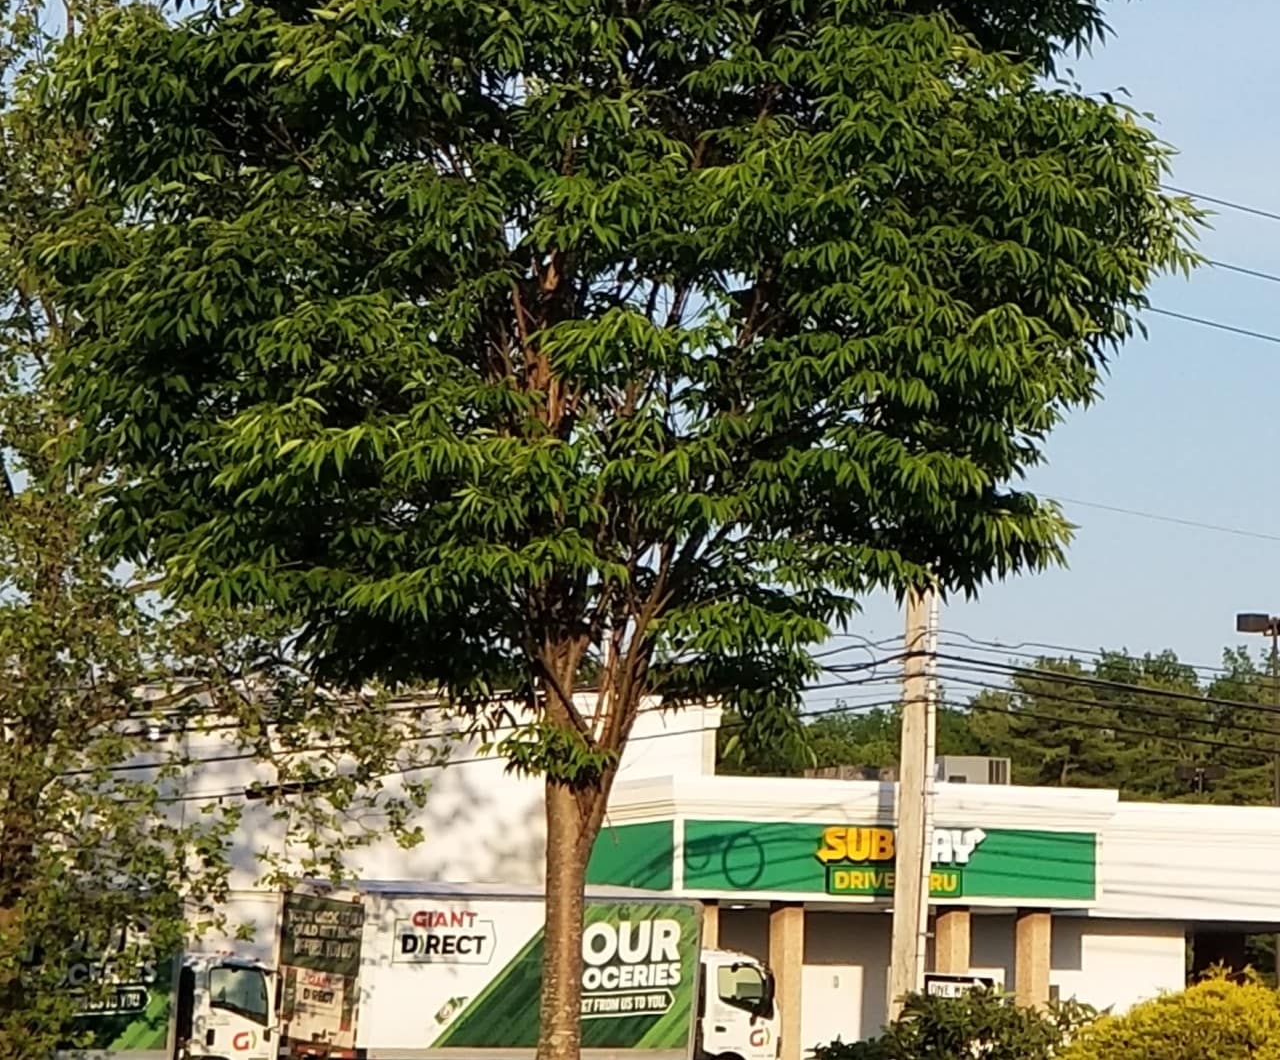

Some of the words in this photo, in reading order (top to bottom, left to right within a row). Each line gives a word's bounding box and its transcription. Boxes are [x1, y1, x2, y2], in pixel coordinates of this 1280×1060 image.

[816, 826, 987, 864] SUBAY
[834, 871, 896, 889] DRIVE
[412, 910, 478, 928] GIANT
[581, 918, 681, 966] OUR
[581, 962, 682, 990] OCERIES
